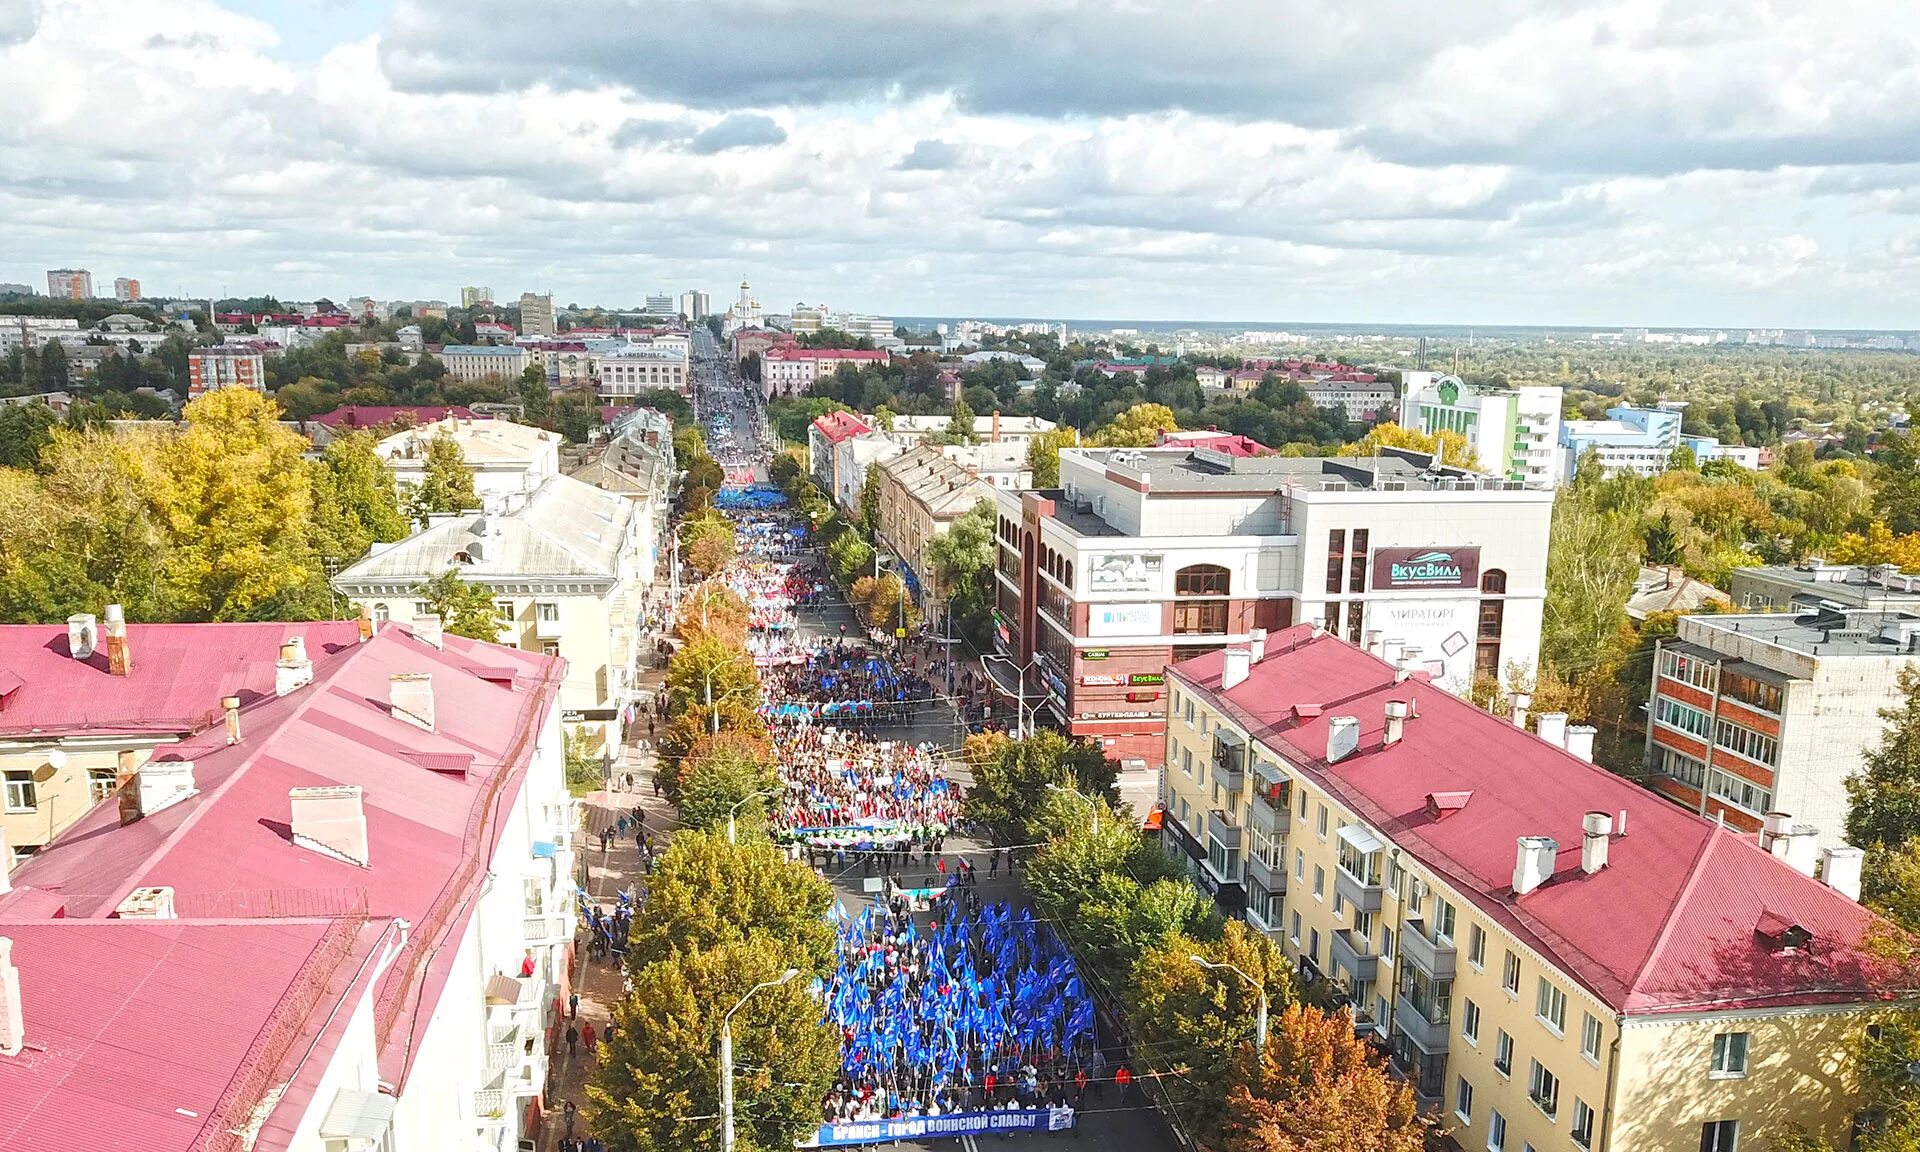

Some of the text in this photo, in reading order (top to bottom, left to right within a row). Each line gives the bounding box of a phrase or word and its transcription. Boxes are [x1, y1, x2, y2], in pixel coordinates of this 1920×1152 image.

[1391, 563, 1461, 579] ВкусВилл
[1389, 608, 1455, 620] МИРАТОРГ
[888, 1121, 926, 1136] ГОРОД
[928, 1114, 989, 1132] ВОИНСКОЙ
[990, 1114, 1036, 1128] СЛАВЫ!
